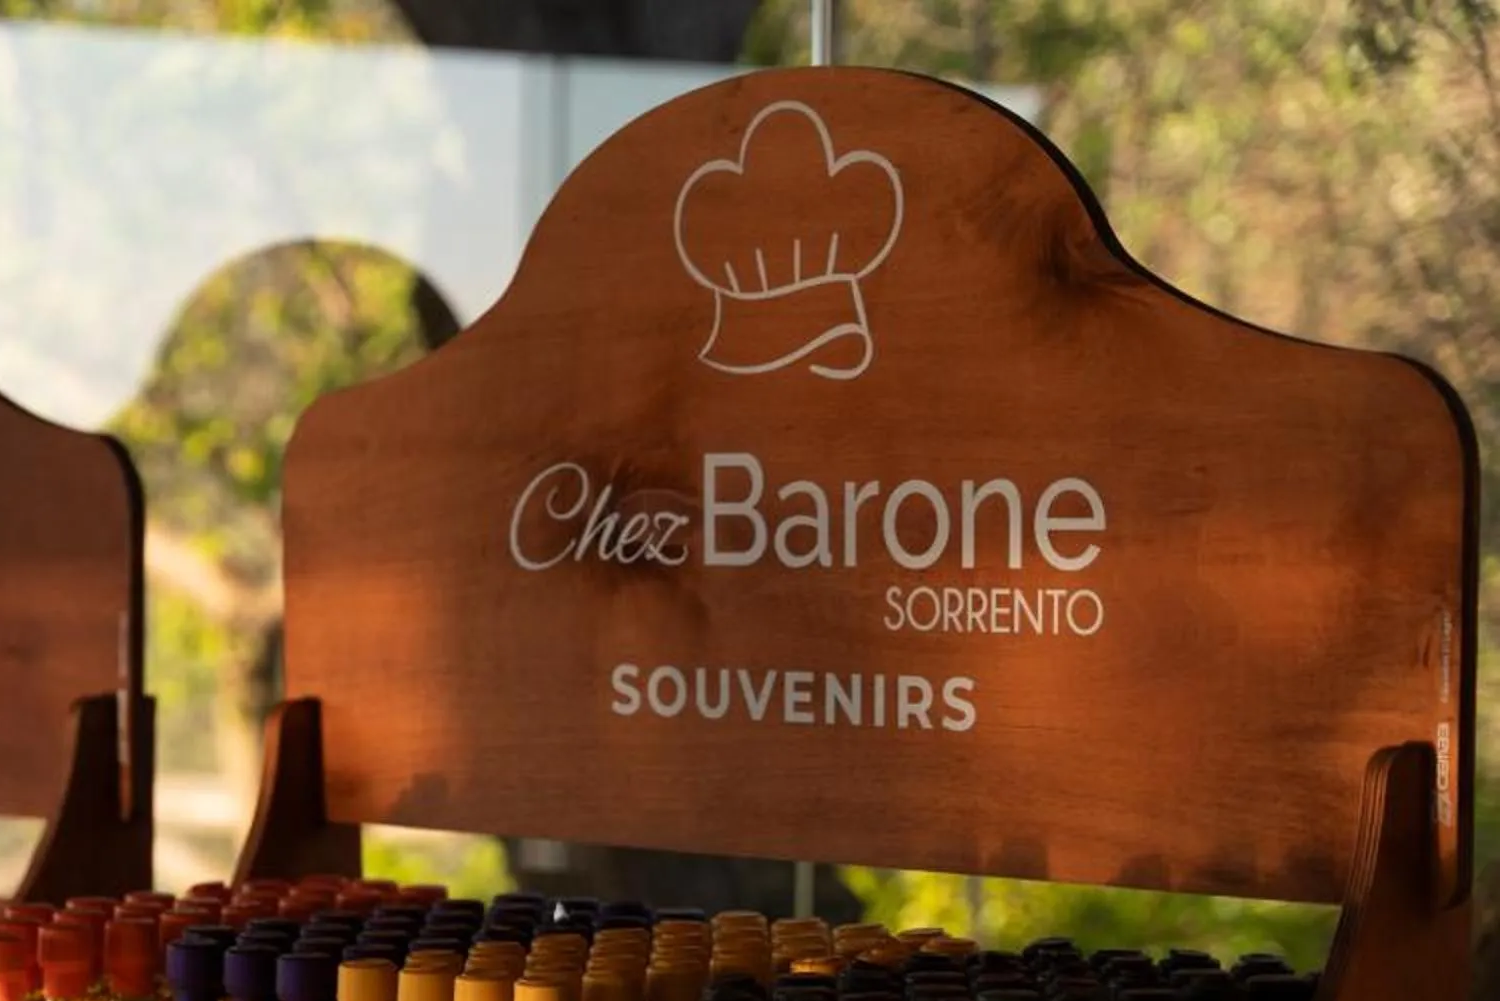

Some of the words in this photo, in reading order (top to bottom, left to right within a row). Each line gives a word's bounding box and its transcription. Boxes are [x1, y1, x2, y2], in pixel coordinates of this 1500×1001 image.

[509, 463, 689, 571] Chez
[703, 452, 1107, 571] Barone
[884, 586, 1105, 635] SORRENTO
[611, 663, 977, 732] SOUVENIRS
